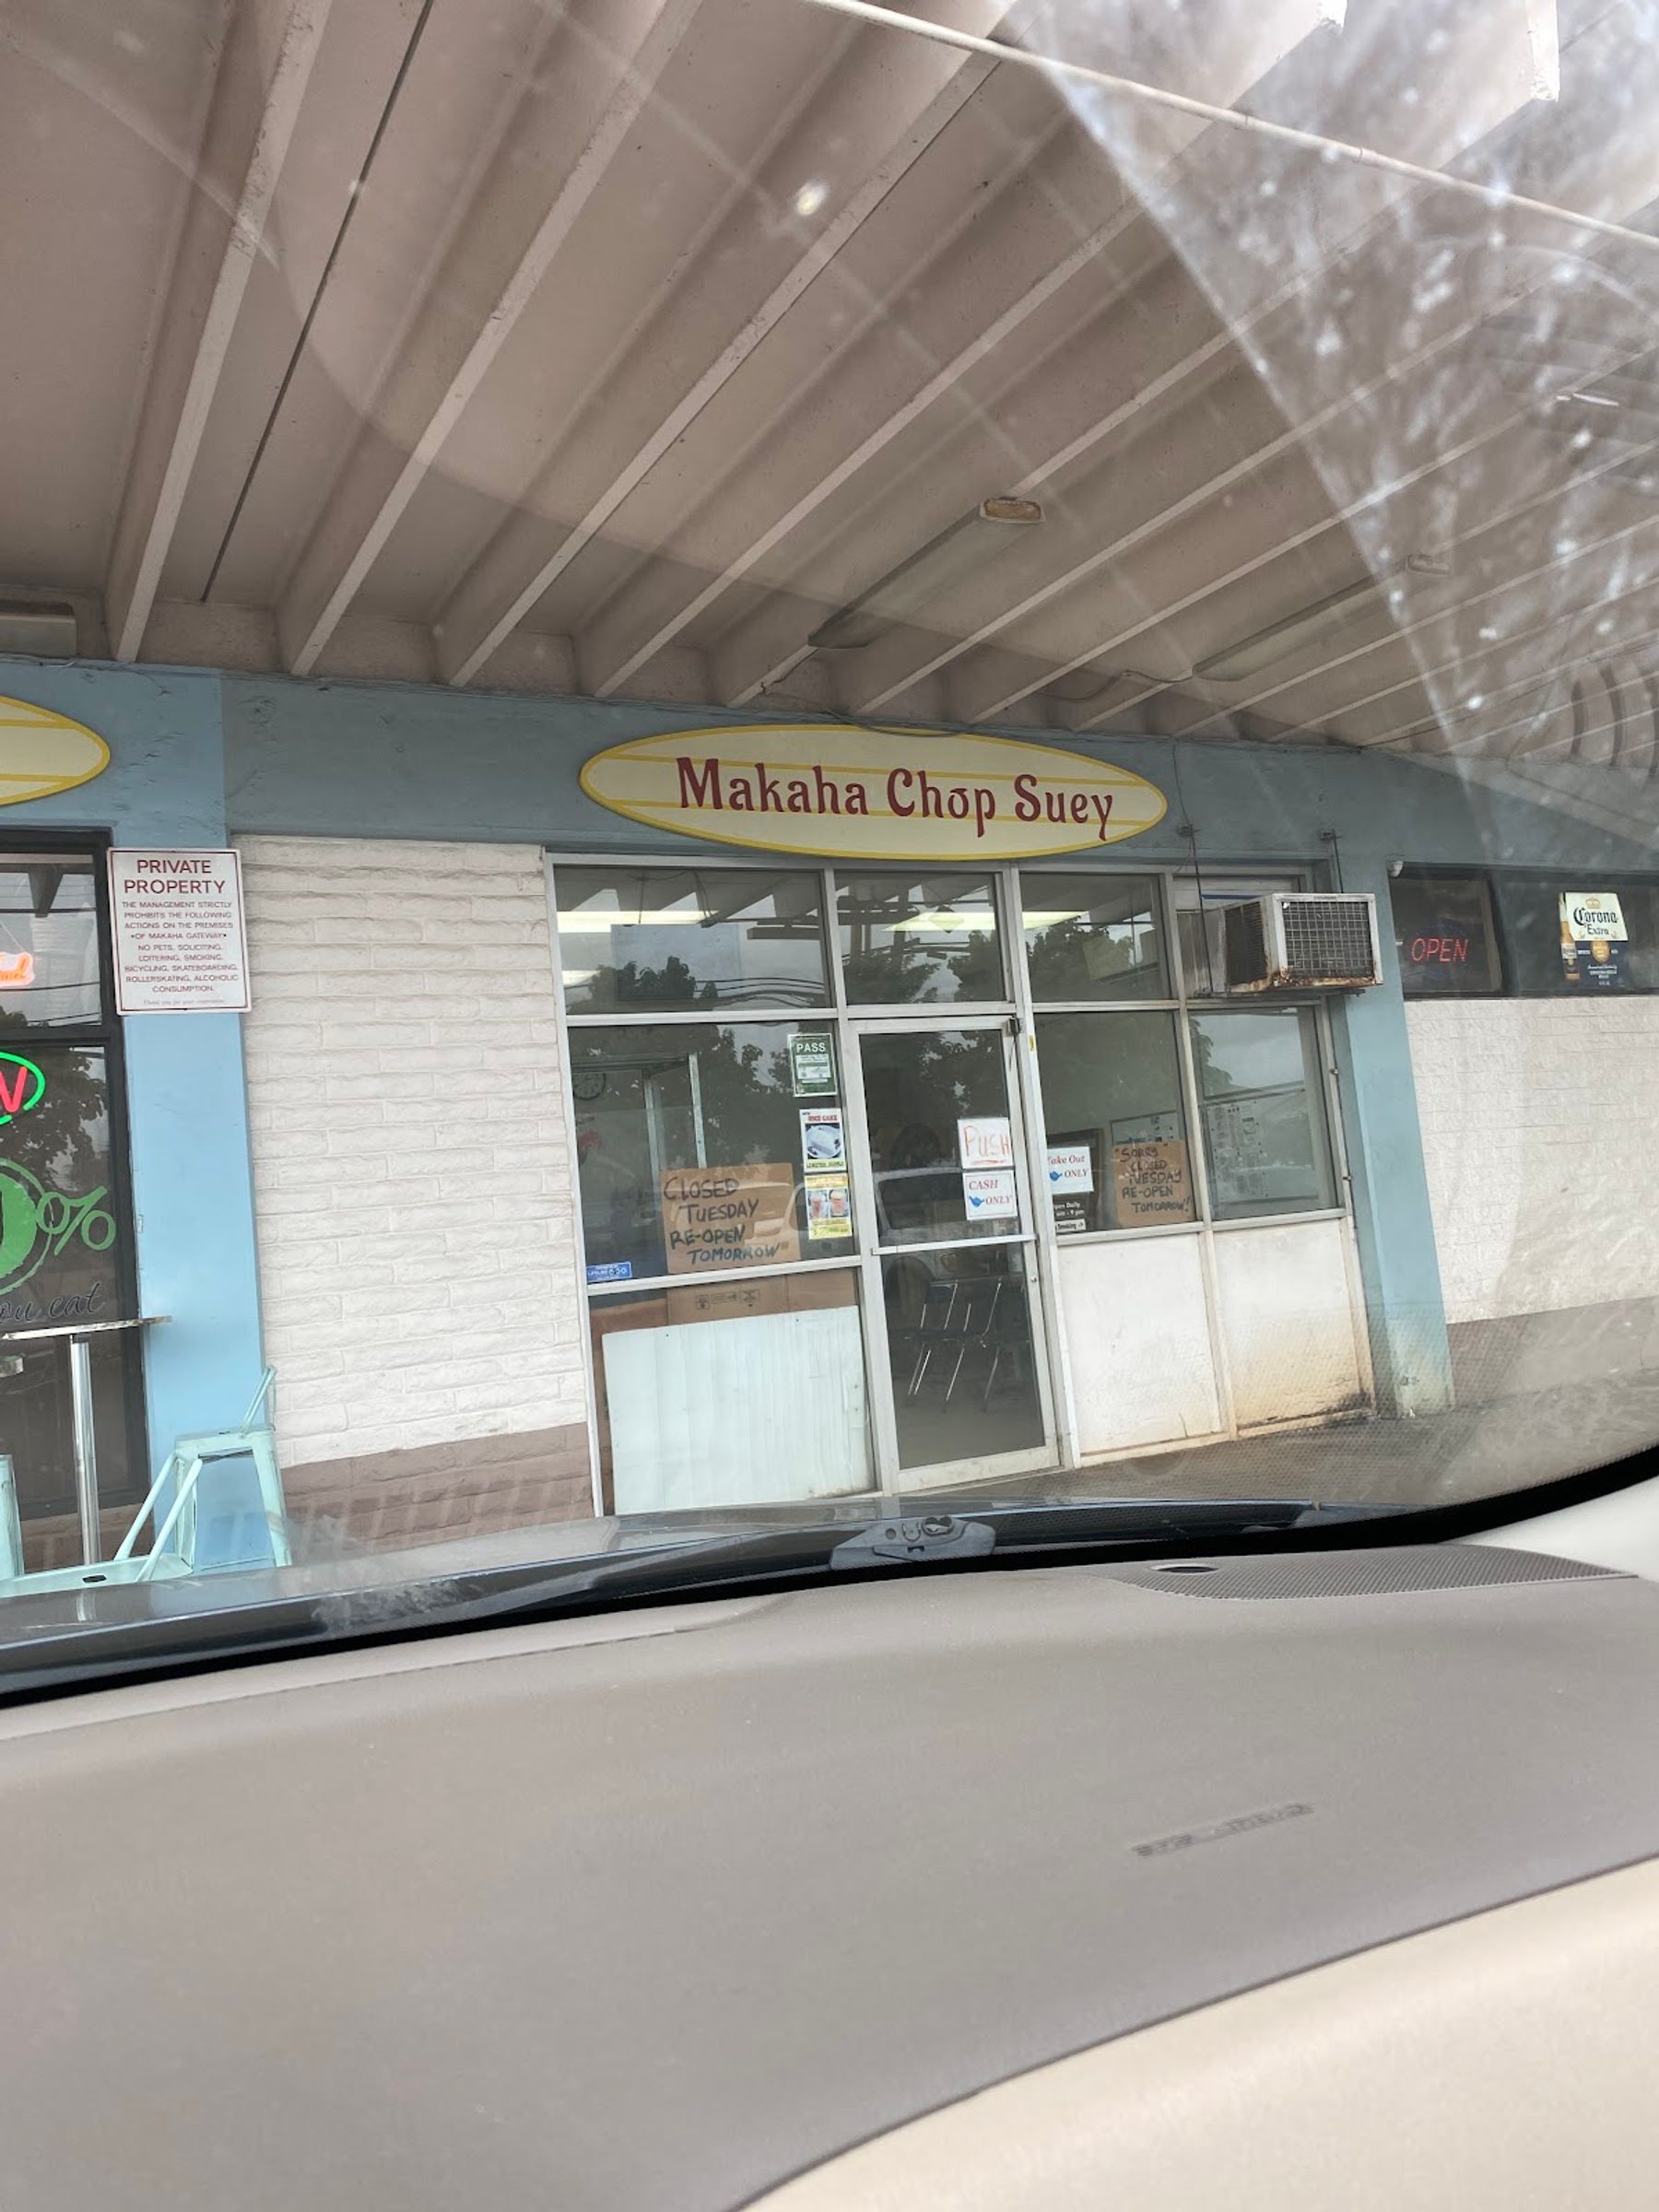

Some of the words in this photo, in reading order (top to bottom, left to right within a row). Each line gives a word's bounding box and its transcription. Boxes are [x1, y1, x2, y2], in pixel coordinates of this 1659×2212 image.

[676, 756, 870, 816] Makaha
[887, 766, 997, 839] Chop
[1014, 772, 1113, 842] Suey
[136, 859, 212, 874] PRIVATE
[124, 879, 226, 894] PROPERTY
[1572, 906, 1618, 926] Corona
[1586, 924, 1609, 935] Extra
[1410, 937, 1469, 963] OPEN
[795, 1041, 827, 1053] PASS
[962, 1124, 1010, 1159] PUSH
[1068, 1154, 1086, 1164] Out
[1064, 1169, 1088, 1178] ONLY
[663, 1176, 740, 1202] CLOSED
[969, 1179, 999, 1191] CASH
[1121, 1185, 1173, 1199] RE-OPEN
[985, 1195, 1012, 1206] ONLY
[678, 1198, 760, 1225] TUESDAY
[669, 1225, 746, 1251] RE-OPEN
[686, 1241, 782, 1265] TOMORROW
